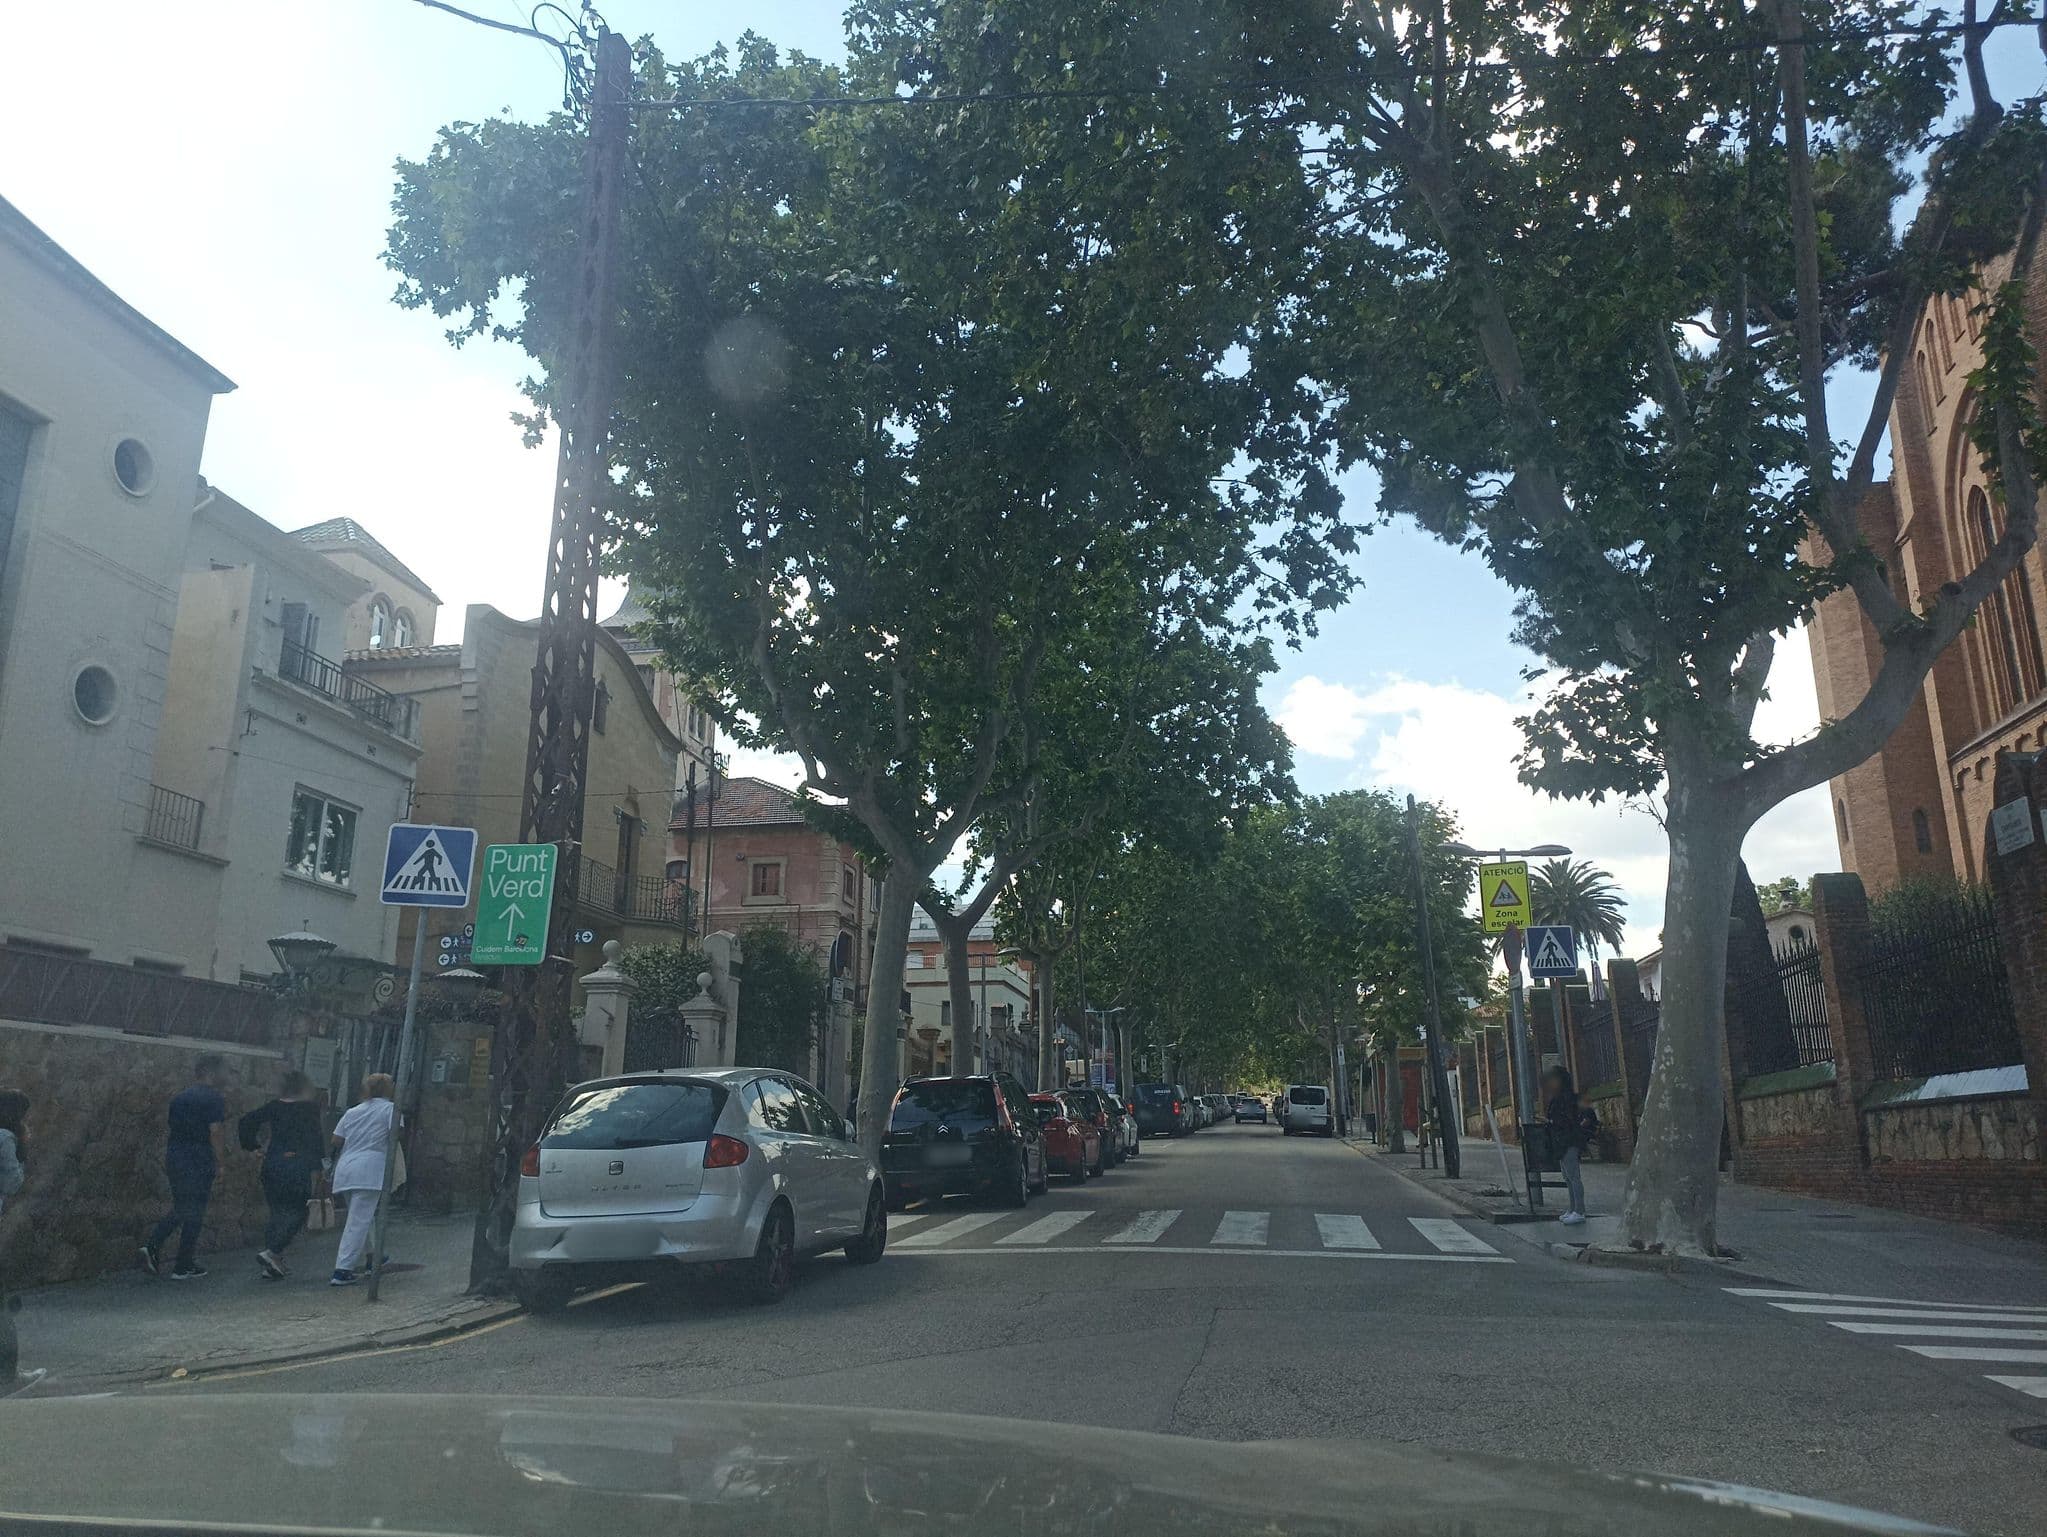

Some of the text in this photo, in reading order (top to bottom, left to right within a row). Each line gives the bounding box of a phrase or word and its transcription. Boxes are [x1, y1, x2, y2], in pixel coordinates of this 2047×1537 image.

[490, 849, 548, 872] Punt
[1484, 867, 1524, 876] ATENCIÓ
[488, 874, 545, 898] Verd
